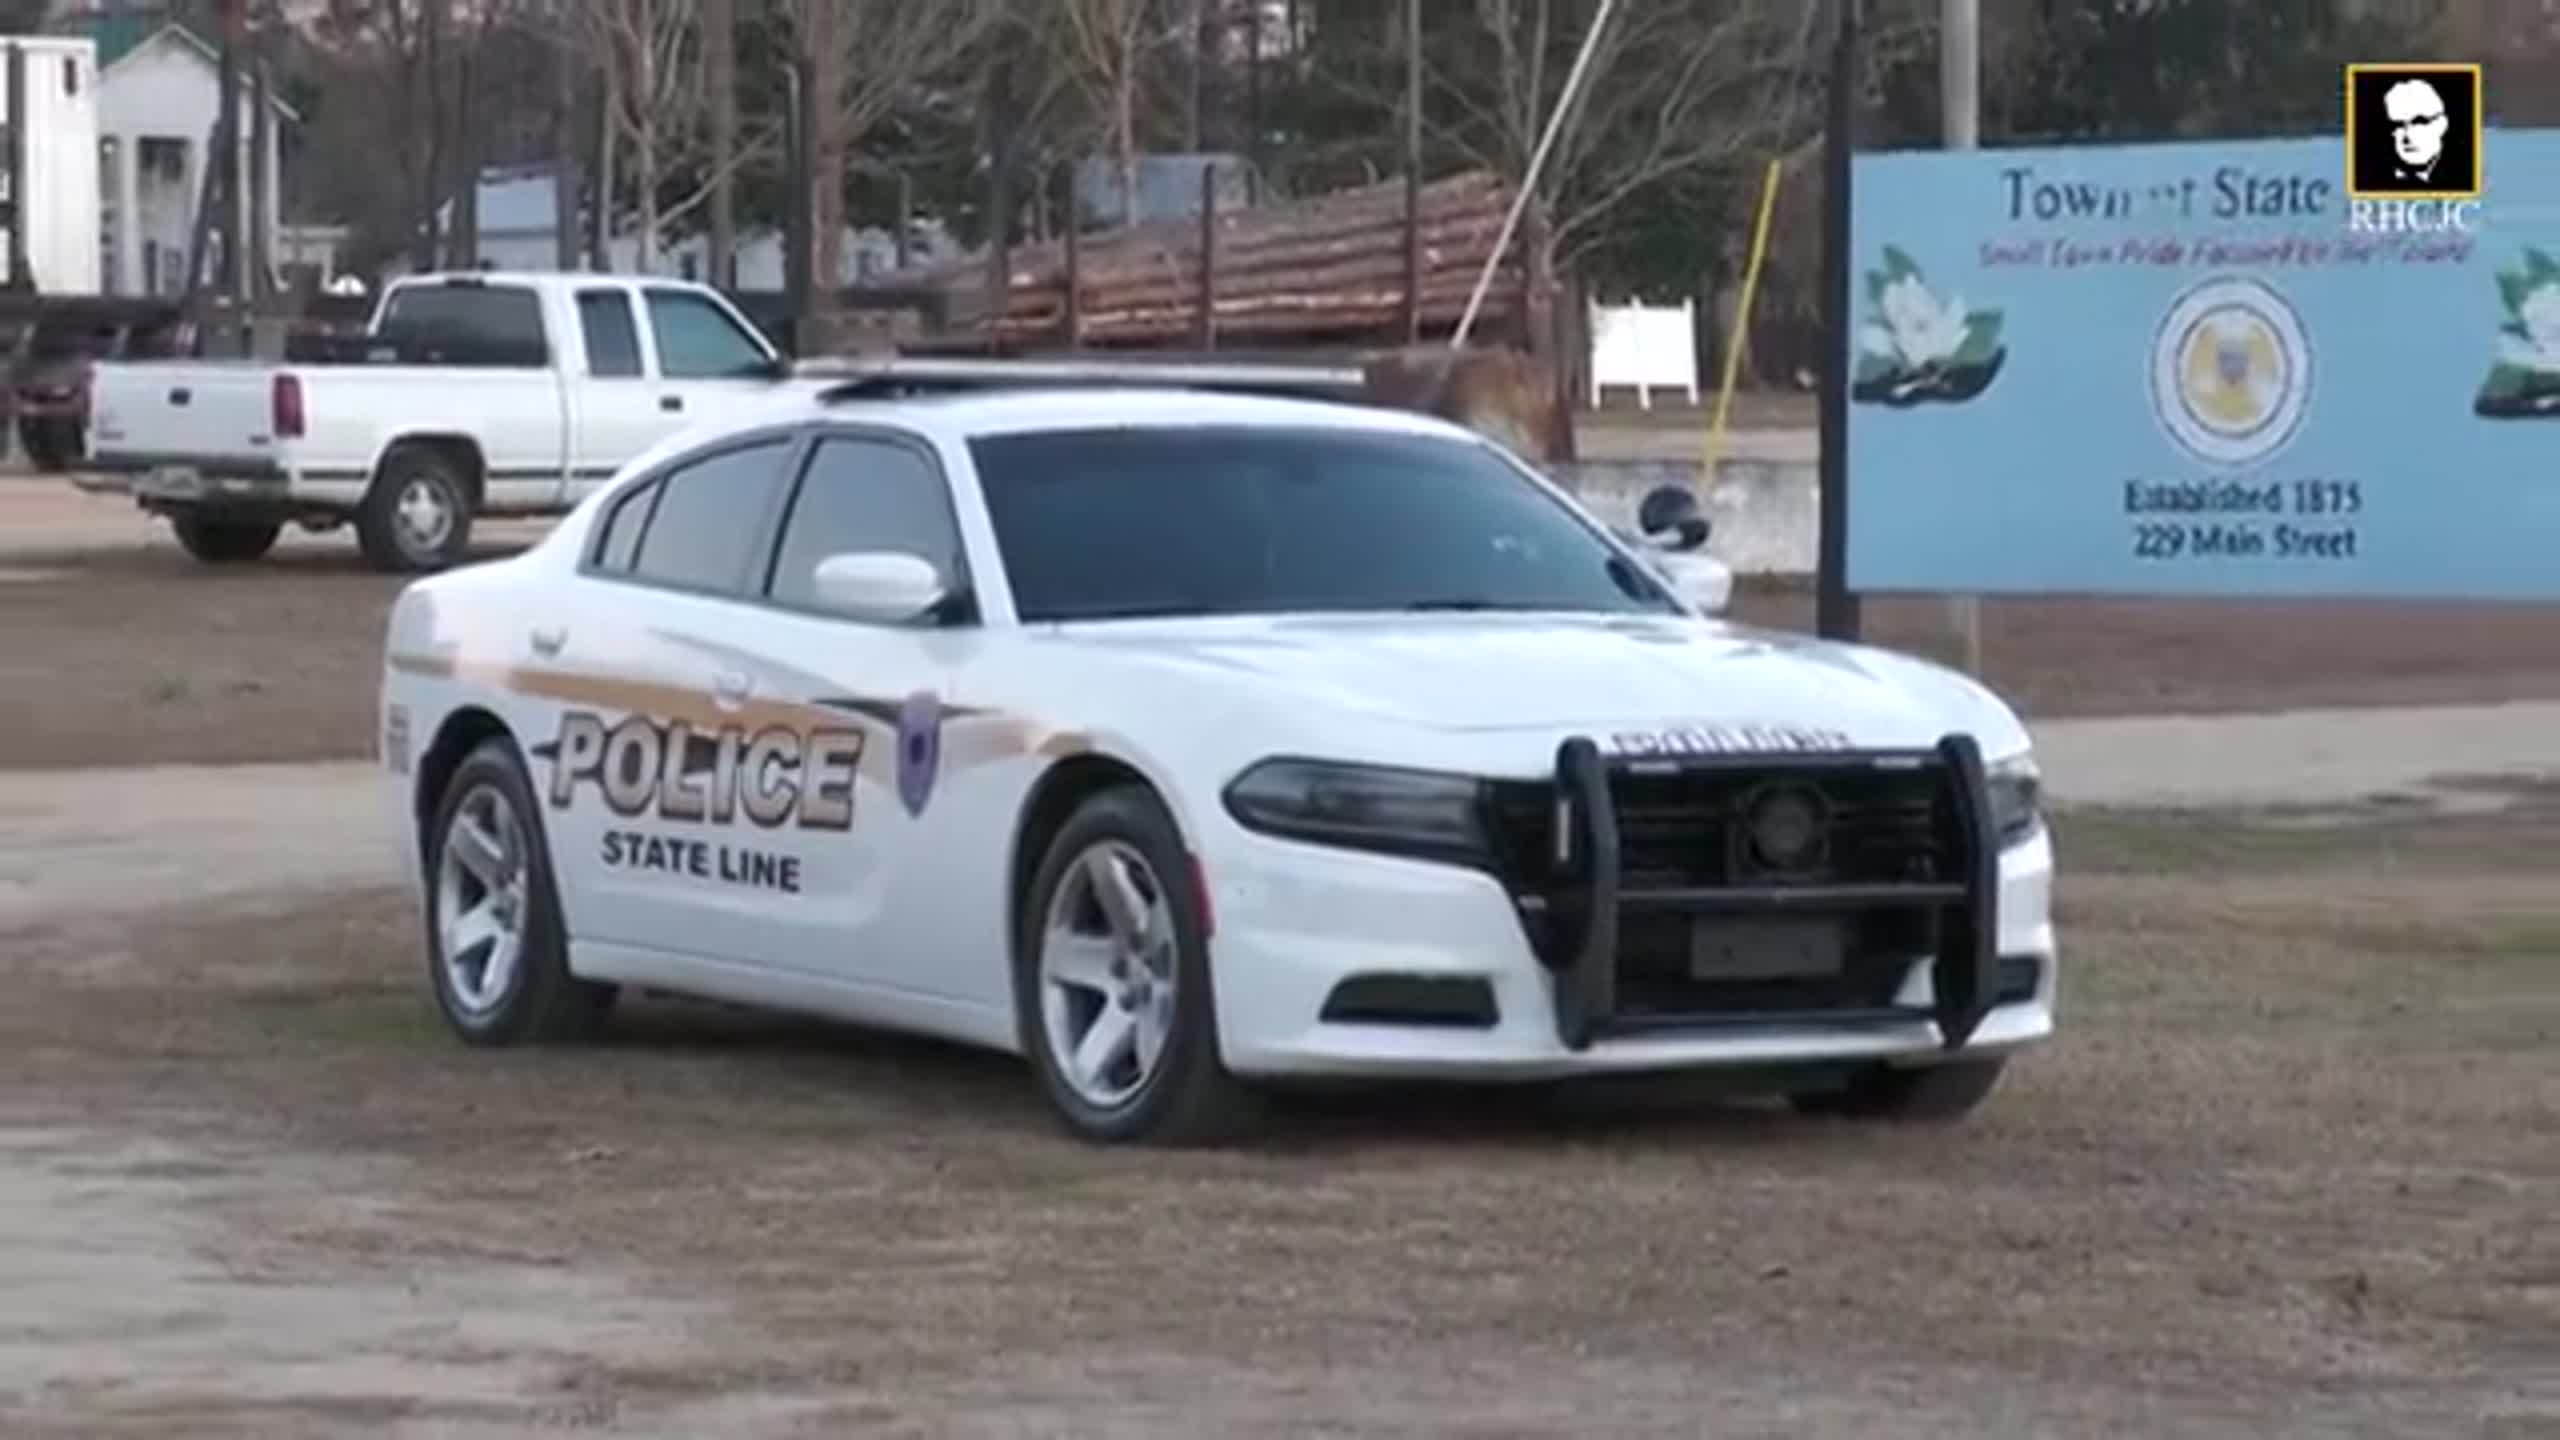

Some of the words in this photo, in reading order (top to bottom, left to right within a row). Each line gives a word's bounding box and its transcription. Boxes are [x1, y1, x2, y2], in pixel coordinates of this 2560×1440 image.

[2001, 166, 2132, 221] Town
[2211, 166, 2331, 219] State
[2124, 480, 2282, 513] Established
[2295, 480, 2362, 513] 1875
[2135, 523, 2185, 558] 229
[2191, 523, 2264, 556] Main
[2274, 523, 2358, 558] Street
[551, 711, 866, 831] POLICE
[602, 830, 710, 877] STATE
[718, 845, 801, 892] LINE
